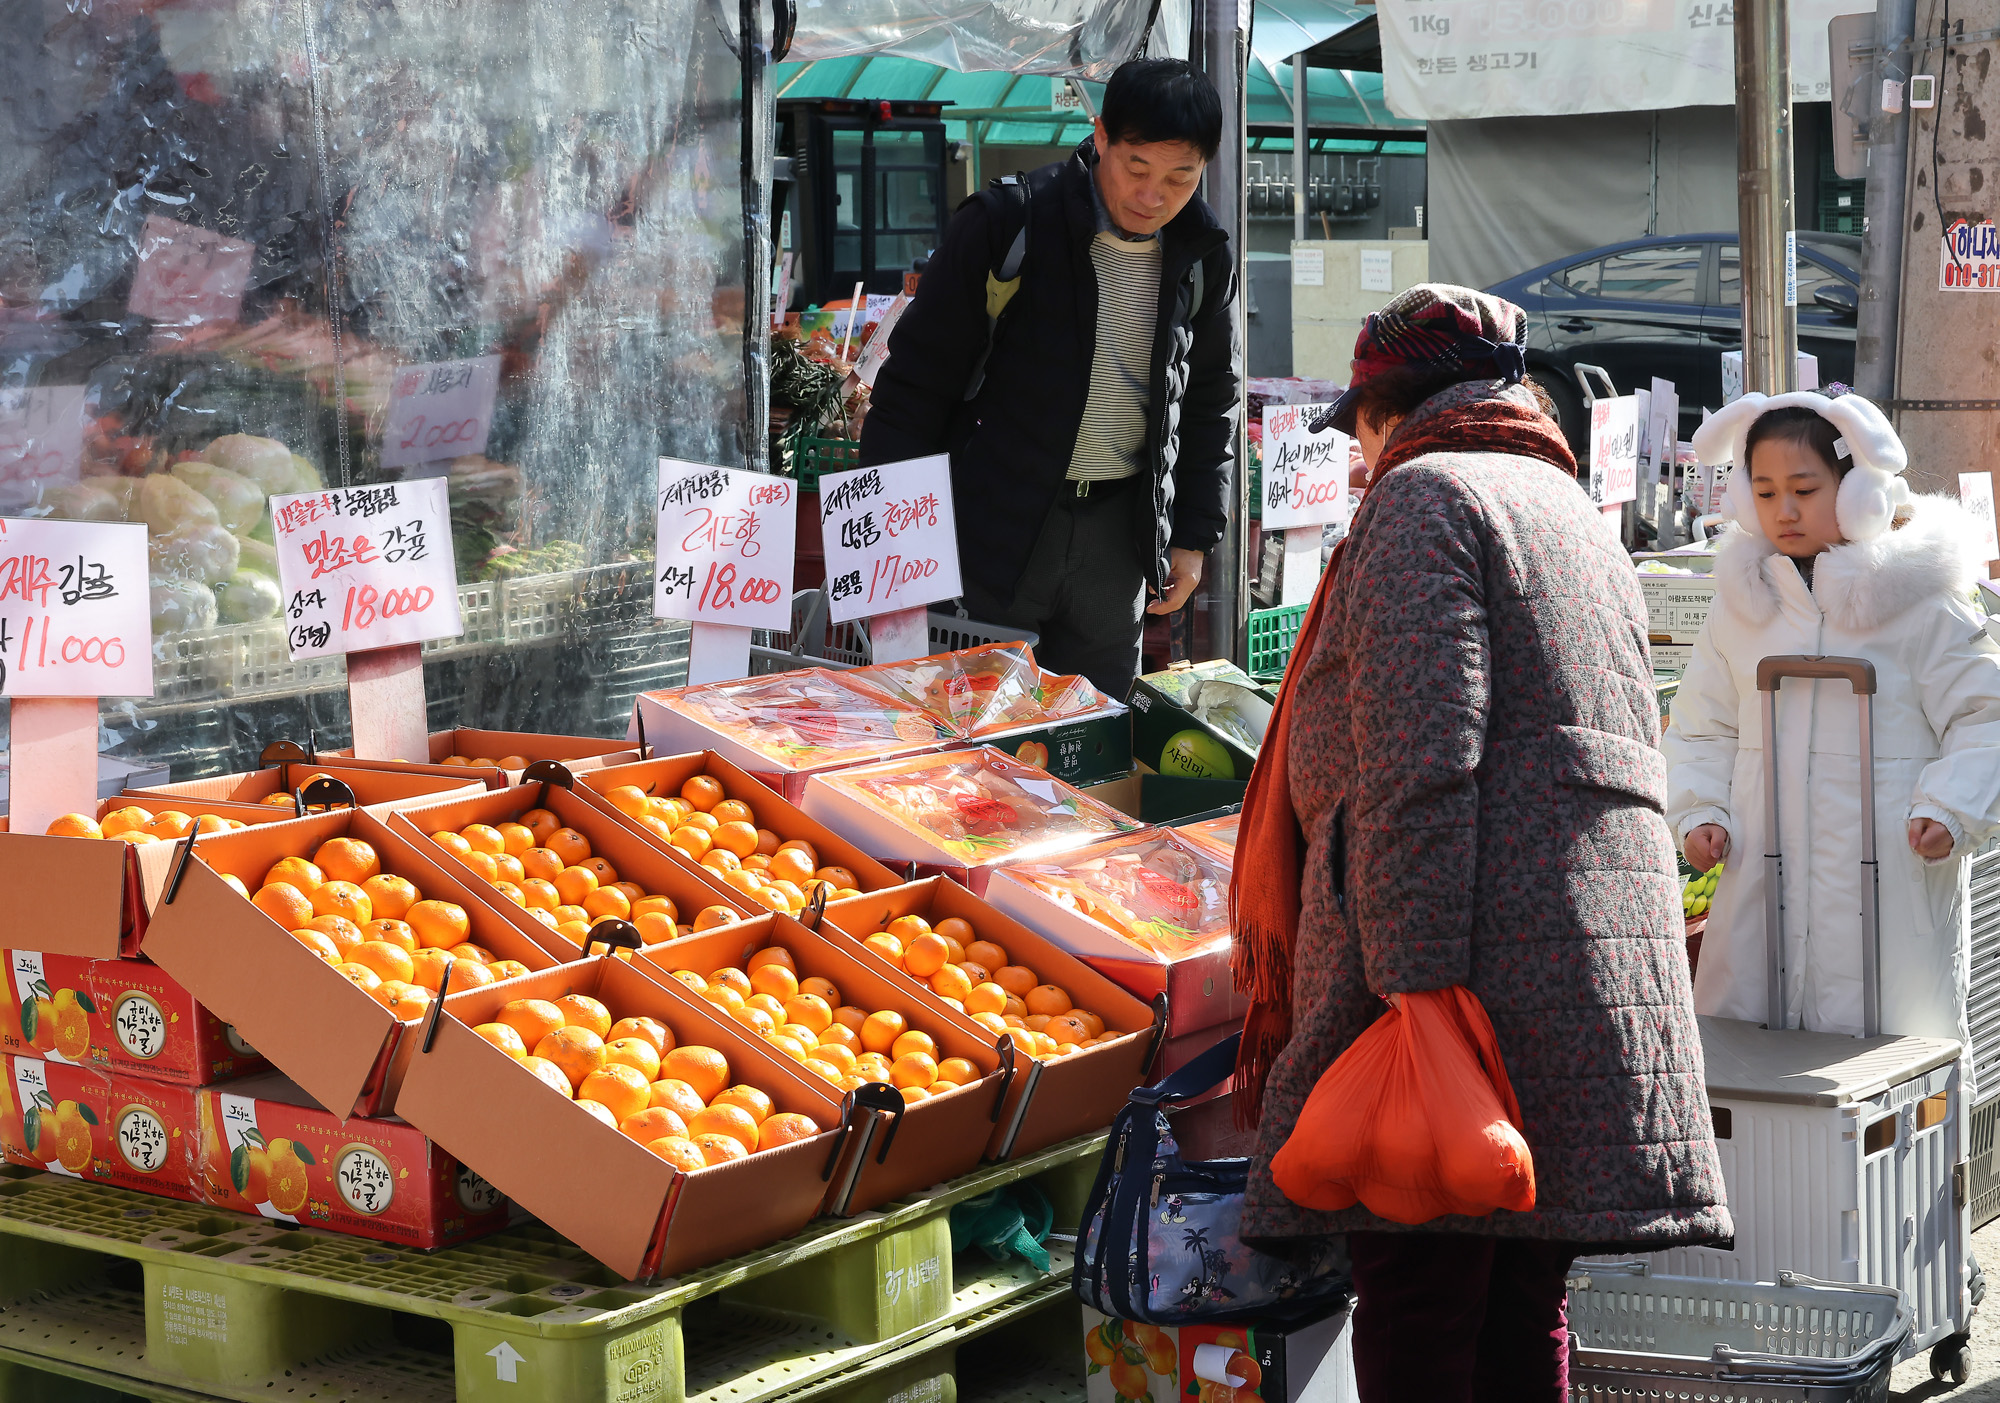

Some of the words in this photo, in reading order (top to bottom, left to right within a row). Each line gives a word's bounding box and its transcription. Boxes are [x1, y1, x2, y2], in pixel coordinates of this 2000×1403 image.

[1408, 14, 1451, 36] 1Kg
[1416, 57, 1457, 75] 한돈
[1467, 52, 1537, 72] 생고기
[1292, 471, 1338, 510] 5.000
[682, 508, 761, 558] 레드향
[841, 511, 881, 550] 명품
[882, 492, 940, 538] 천혜향
[0, 554, 58, 608] 제주
[58, 554, 120, 606] 감귤
[660, 566, 697, 600] 상자
[698, 561, 782, 613] 18.000
[867, 554, 939, 604] 17.000
[287, 588, 327, 619] 상자
[18, 616, 126, 672] 11.000
[19, 958, 38, 974] Jeju
[130, 1000, 161, 1033] 귤빛향
[4, 1035, 20, 1049] 5kg
[118, 1015, 155, 1056] 감귤
[22, 1068, 41, 1083] Jeju
[133, 1114, 164, 1147] 귤빛향
[229, 1104, 250, 1122] Jeju
[121, 1128, 157, 1169] 감귤
[353, 1153, 390, 1188] 귤빛향
[212, 1183, 229, 1199] 5kg
[340, 1168, 381, 1212] 감귤
